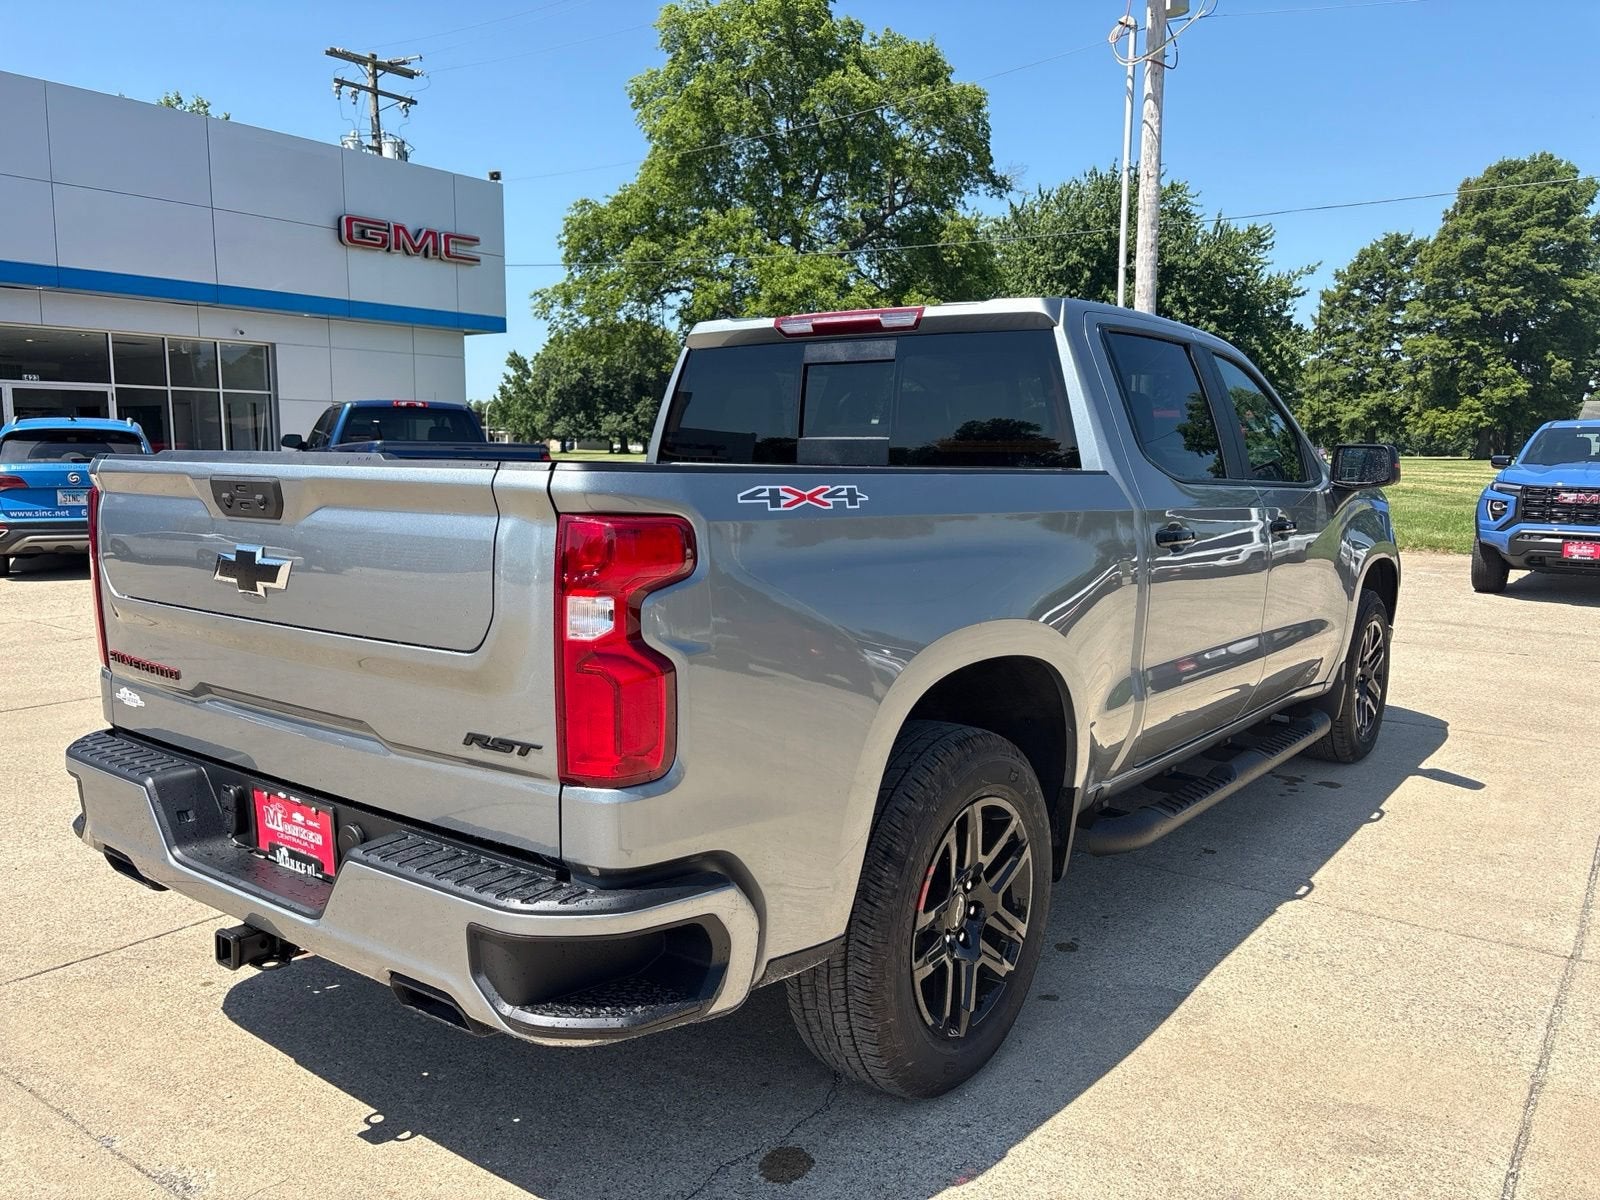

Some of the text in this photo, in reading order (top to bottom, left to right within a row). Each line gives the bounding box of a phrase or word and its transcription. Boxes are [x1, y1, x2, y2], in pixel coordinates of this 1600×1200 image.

[338, 214, 481, 265] GMC
[63, 493, 80, 503] SINC
[1557, 493, 1600, 504] GM
[9, 510, 70, 518] www.sinc.net
[109, 649, 182, 681] SILVERADO
[462, 732, 544, 757] RST
